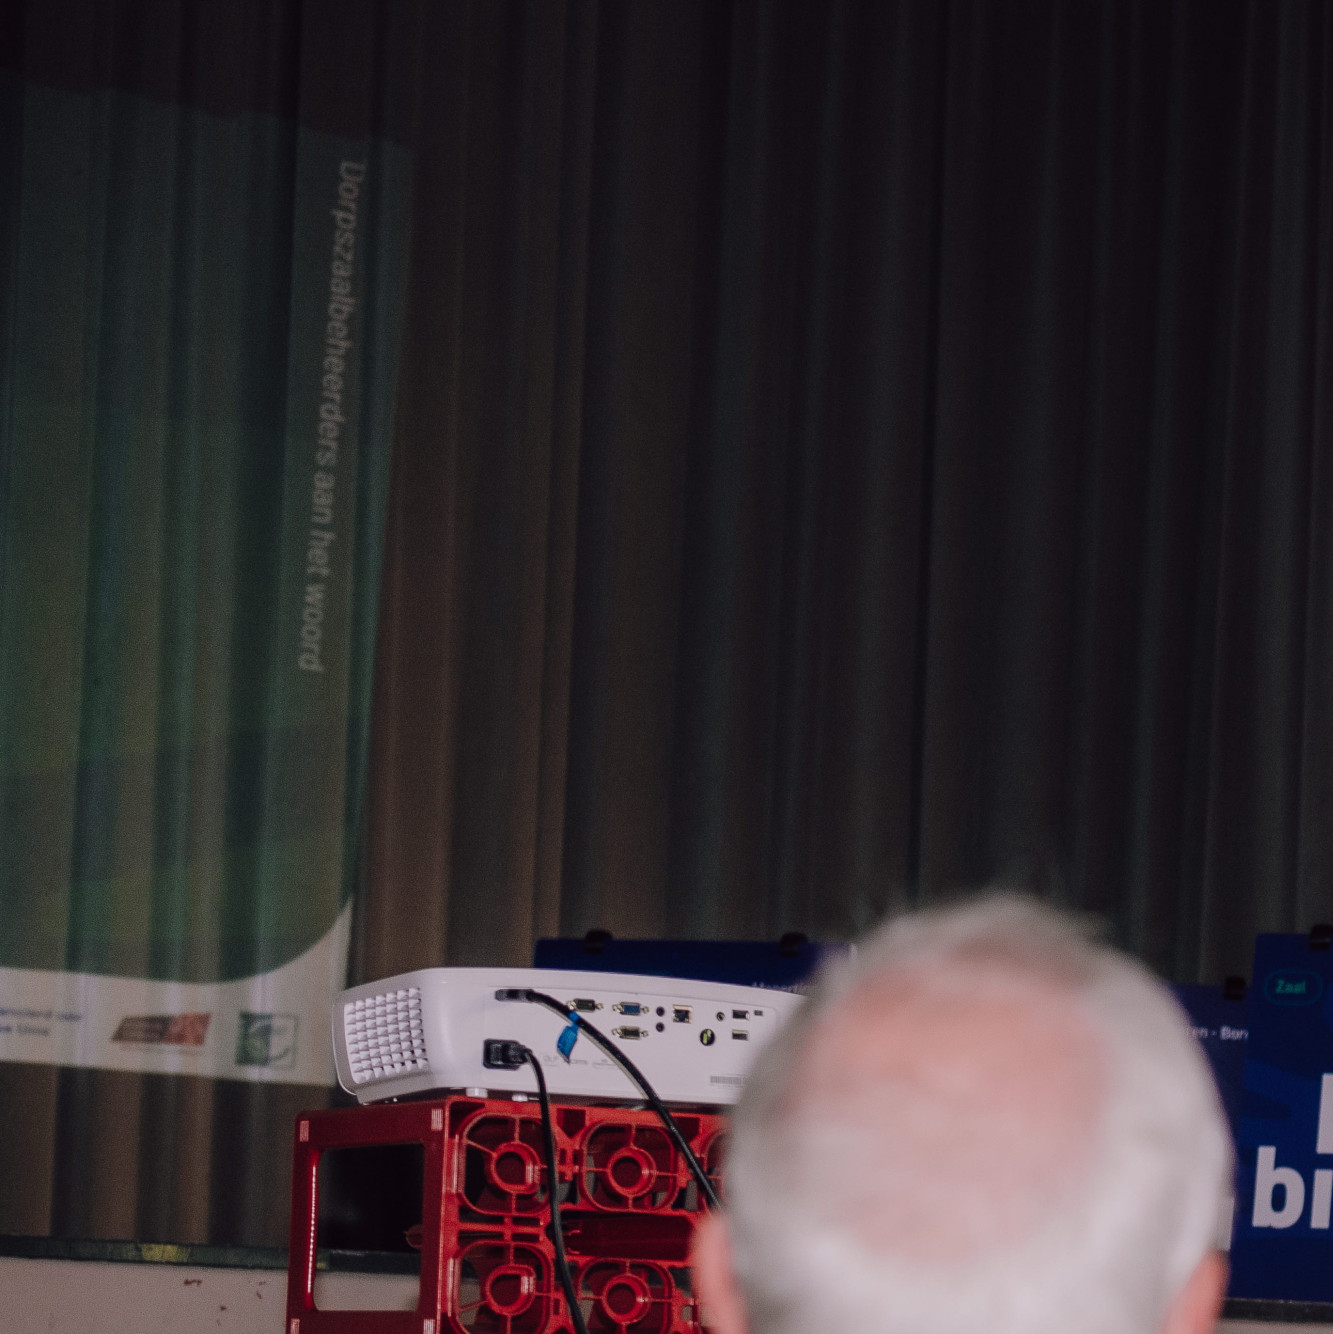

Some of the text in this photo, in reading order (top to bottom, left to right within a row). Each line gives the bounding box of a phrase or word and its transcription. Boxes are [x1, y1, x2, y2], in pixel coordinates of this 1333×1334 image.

[298, 159, 365, 672] Dorpszaalbeheerders aan het woord
[1275, 978, 1306, 995] Zaal
